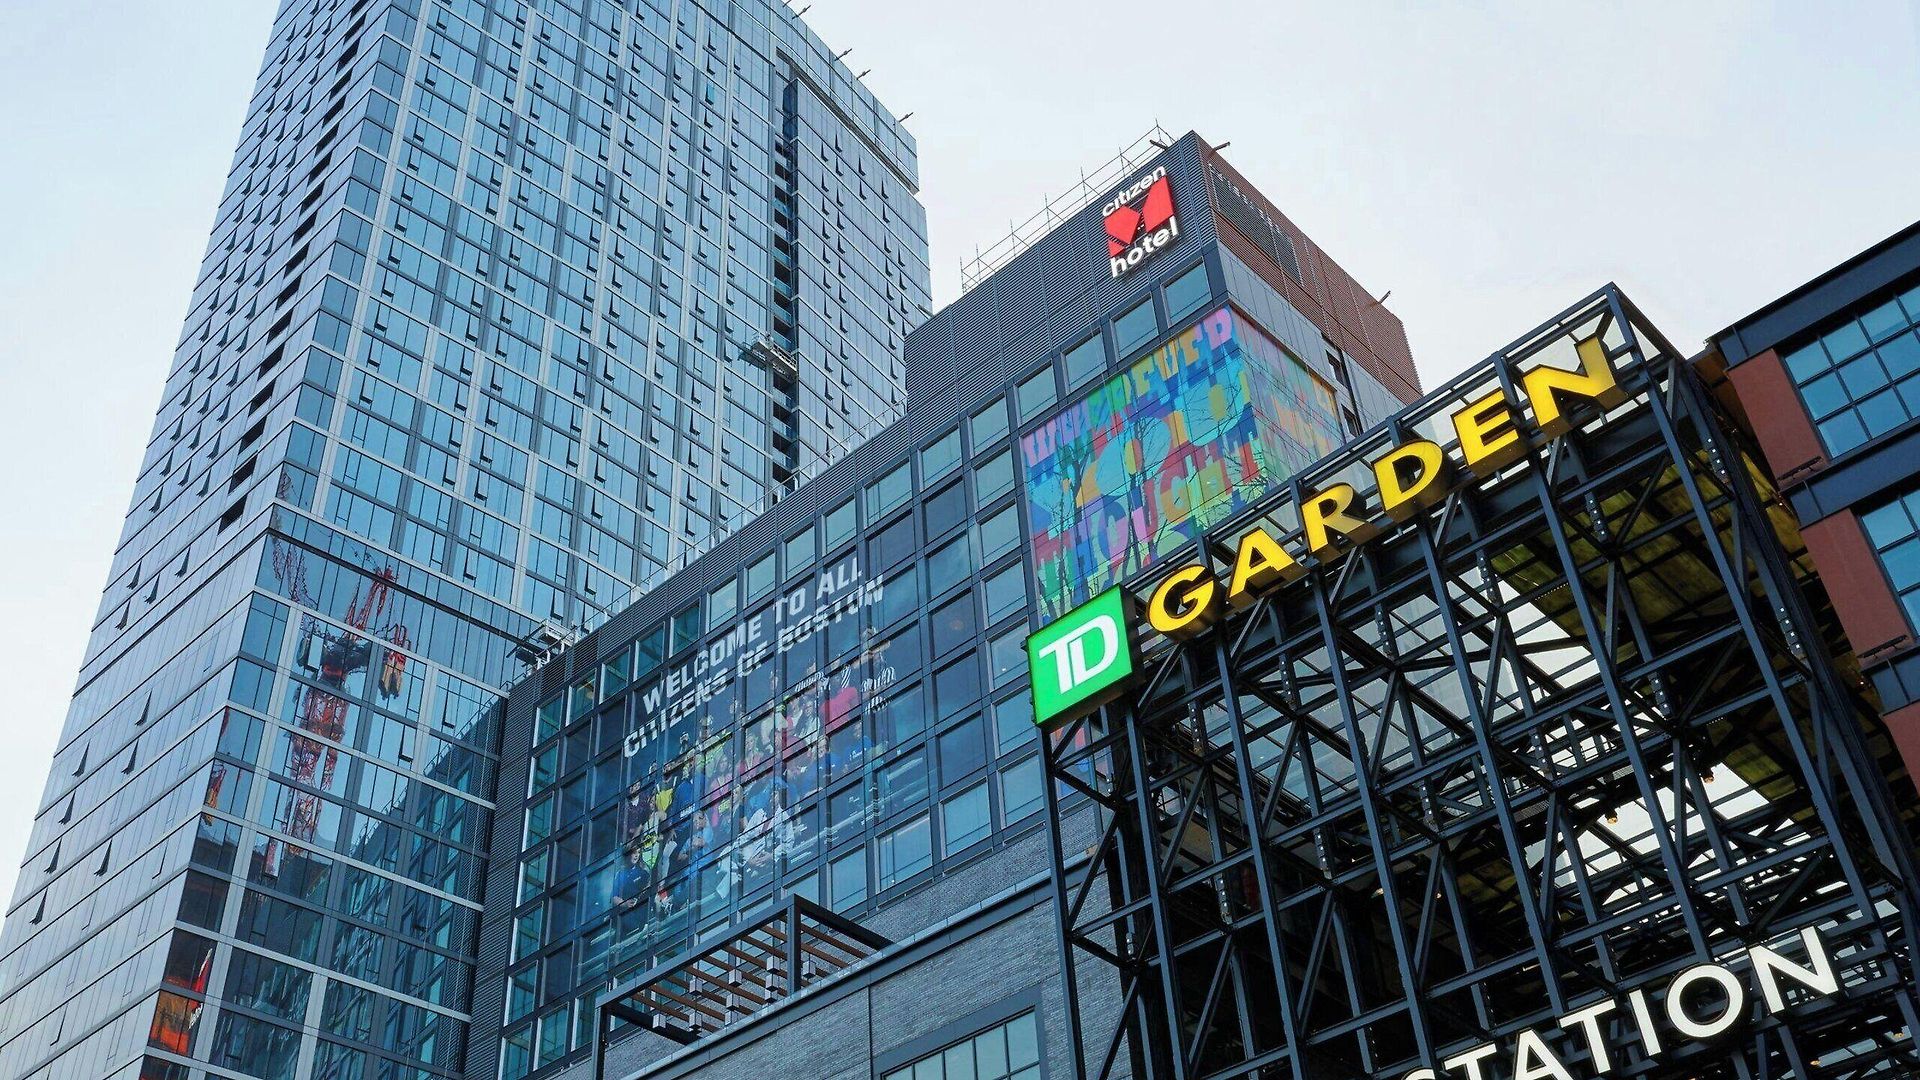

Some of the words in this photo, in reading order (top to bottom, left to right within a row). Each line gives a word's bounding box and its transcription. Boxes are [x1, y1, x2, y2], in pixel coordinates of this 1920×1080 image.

[1102, 165, 1167, 217] citizen
[1109, 215, 1179, 278] hotel
[1038, 614, 1119, 696] TD
[1147, 334, 1620, 633] GARDEN
[623, 667, 729, 759] CITIZENS
[737, 640, 768, 677] OF
[778, 574, 884, 654] BOSTON
[643, 614, 762, 715] WELCOME
[773, 587, 807, 624] TO
[817, 557, 862, 599] ALL
[1402, 925, 1841, 1080] TATION
